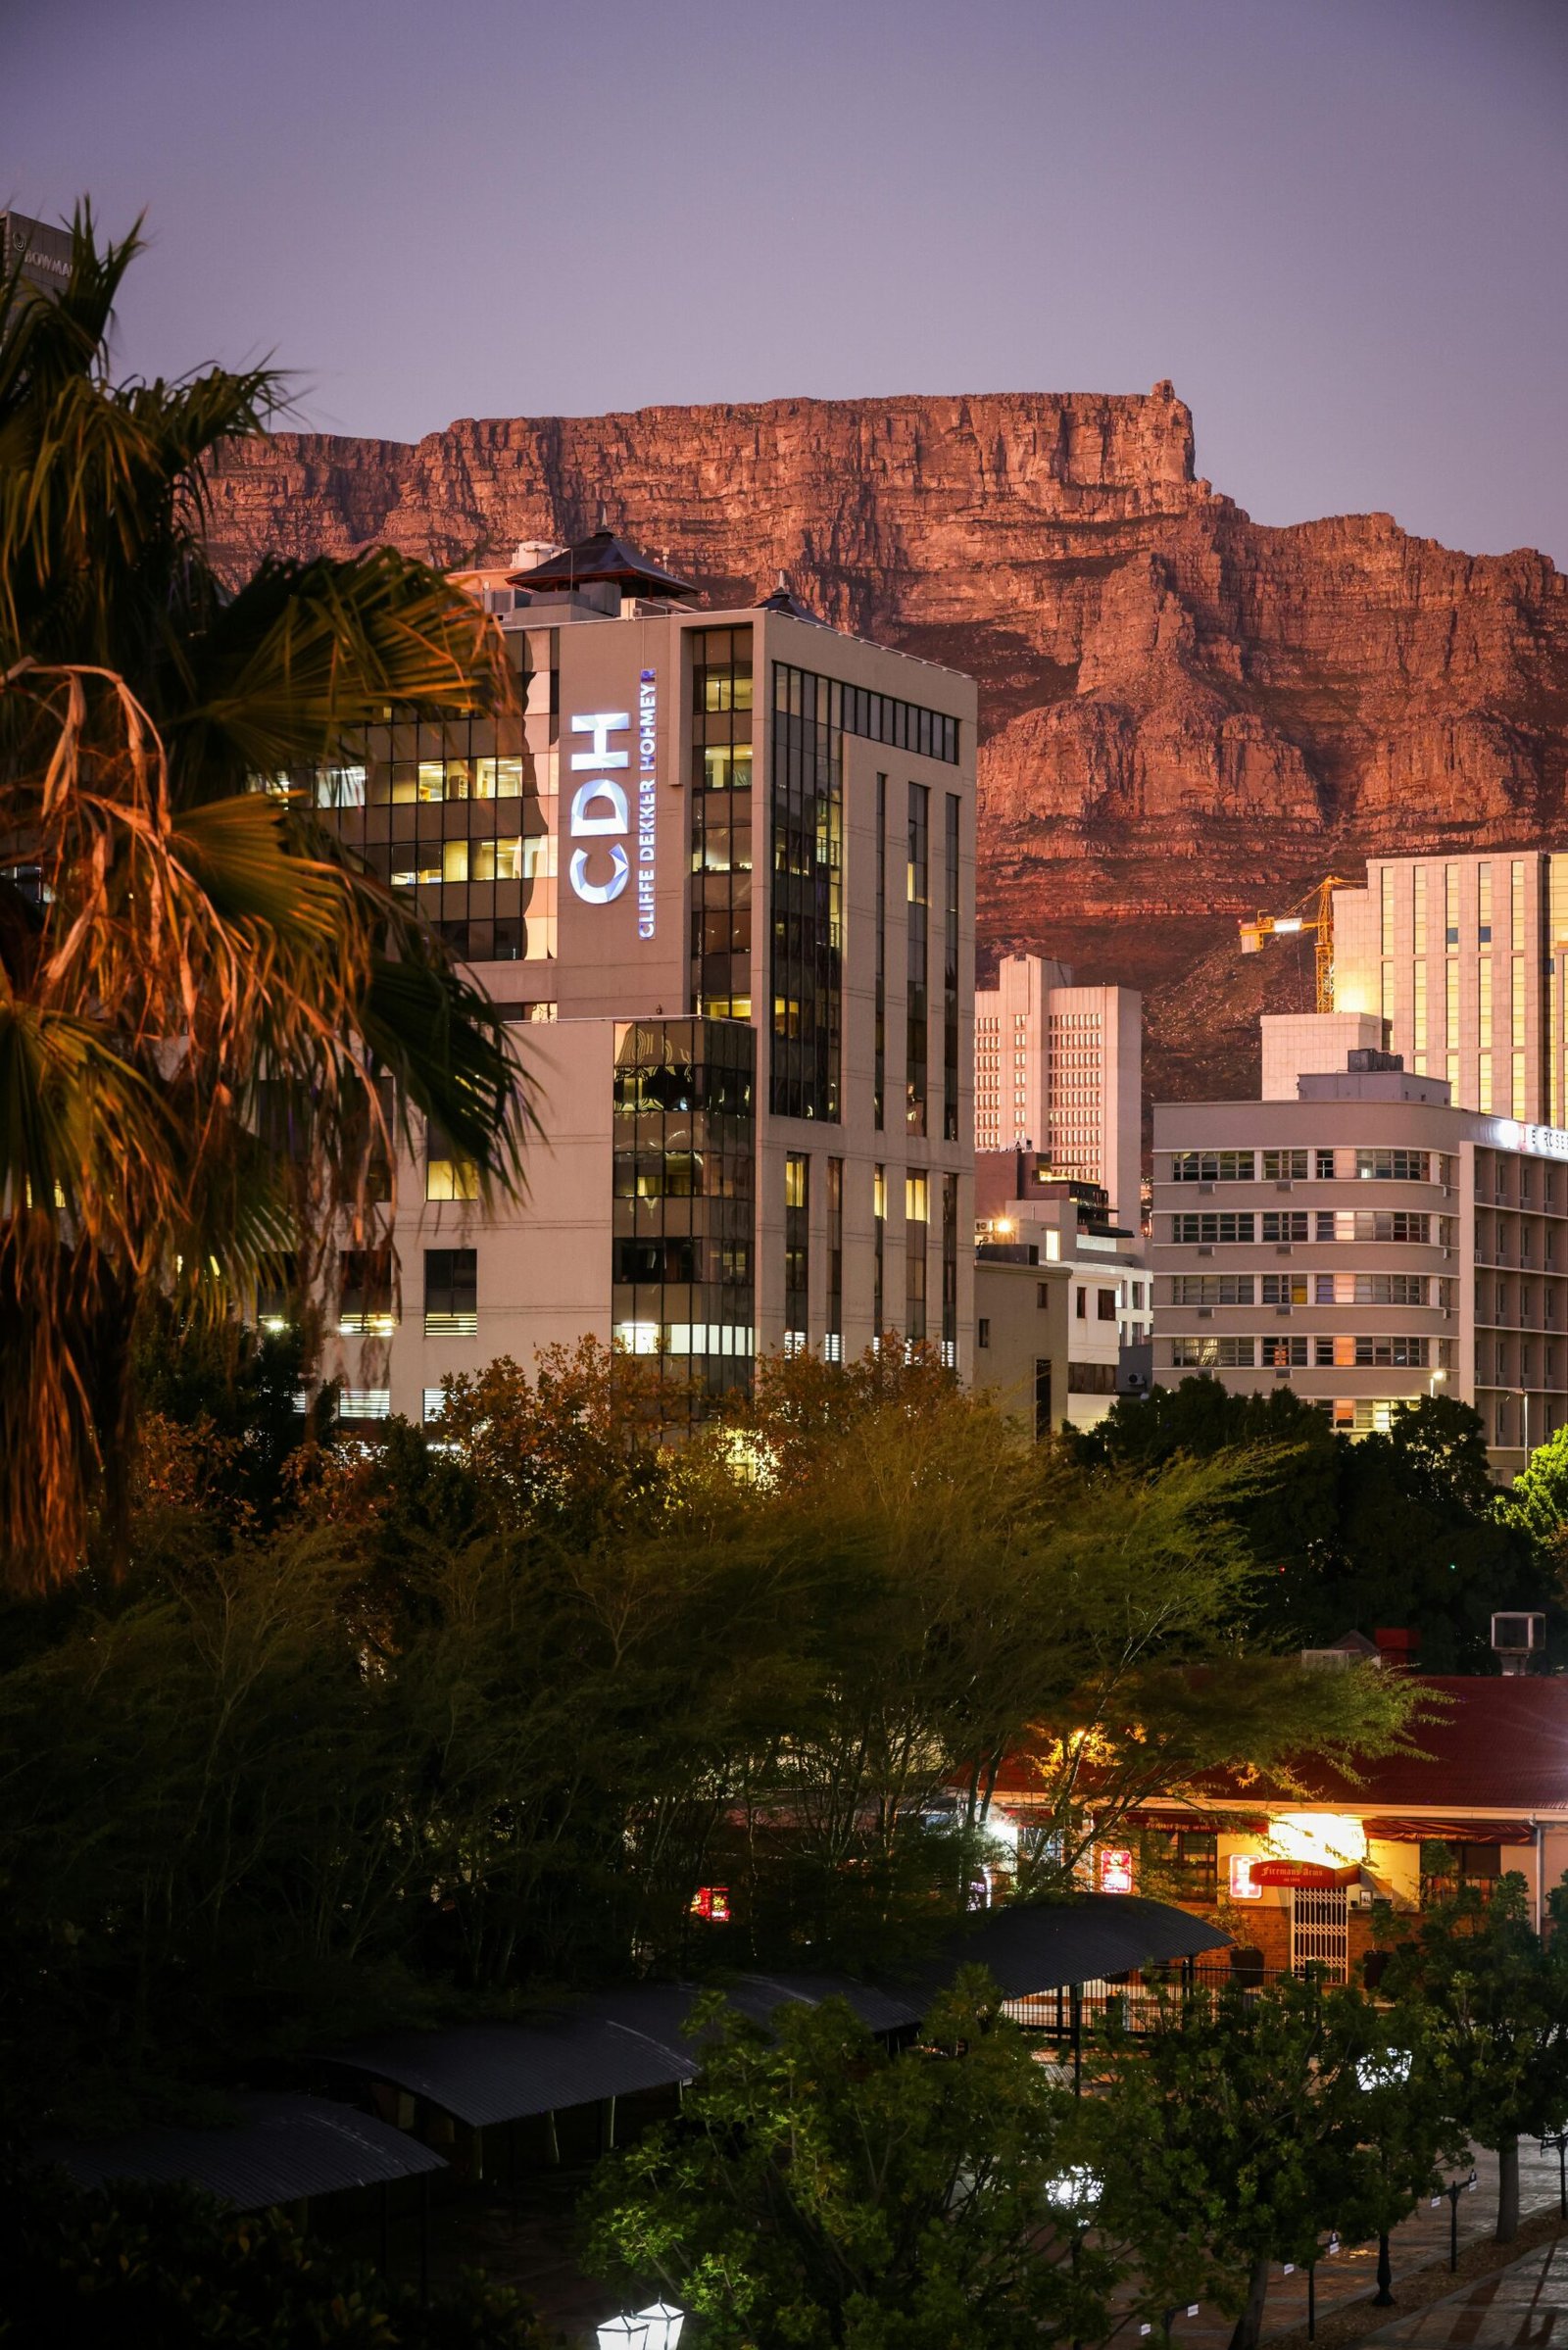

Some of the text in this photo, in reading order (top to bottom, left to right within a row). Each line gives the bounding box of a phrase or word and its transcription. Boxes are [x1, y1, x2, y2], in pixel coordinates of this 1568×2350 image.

[569, 711, 630, 905] CDH
[638, 668, 657, 939] CLIFFE DEKKER HOFMEYR
[1302, 1868, 1323, 1877] Arms
